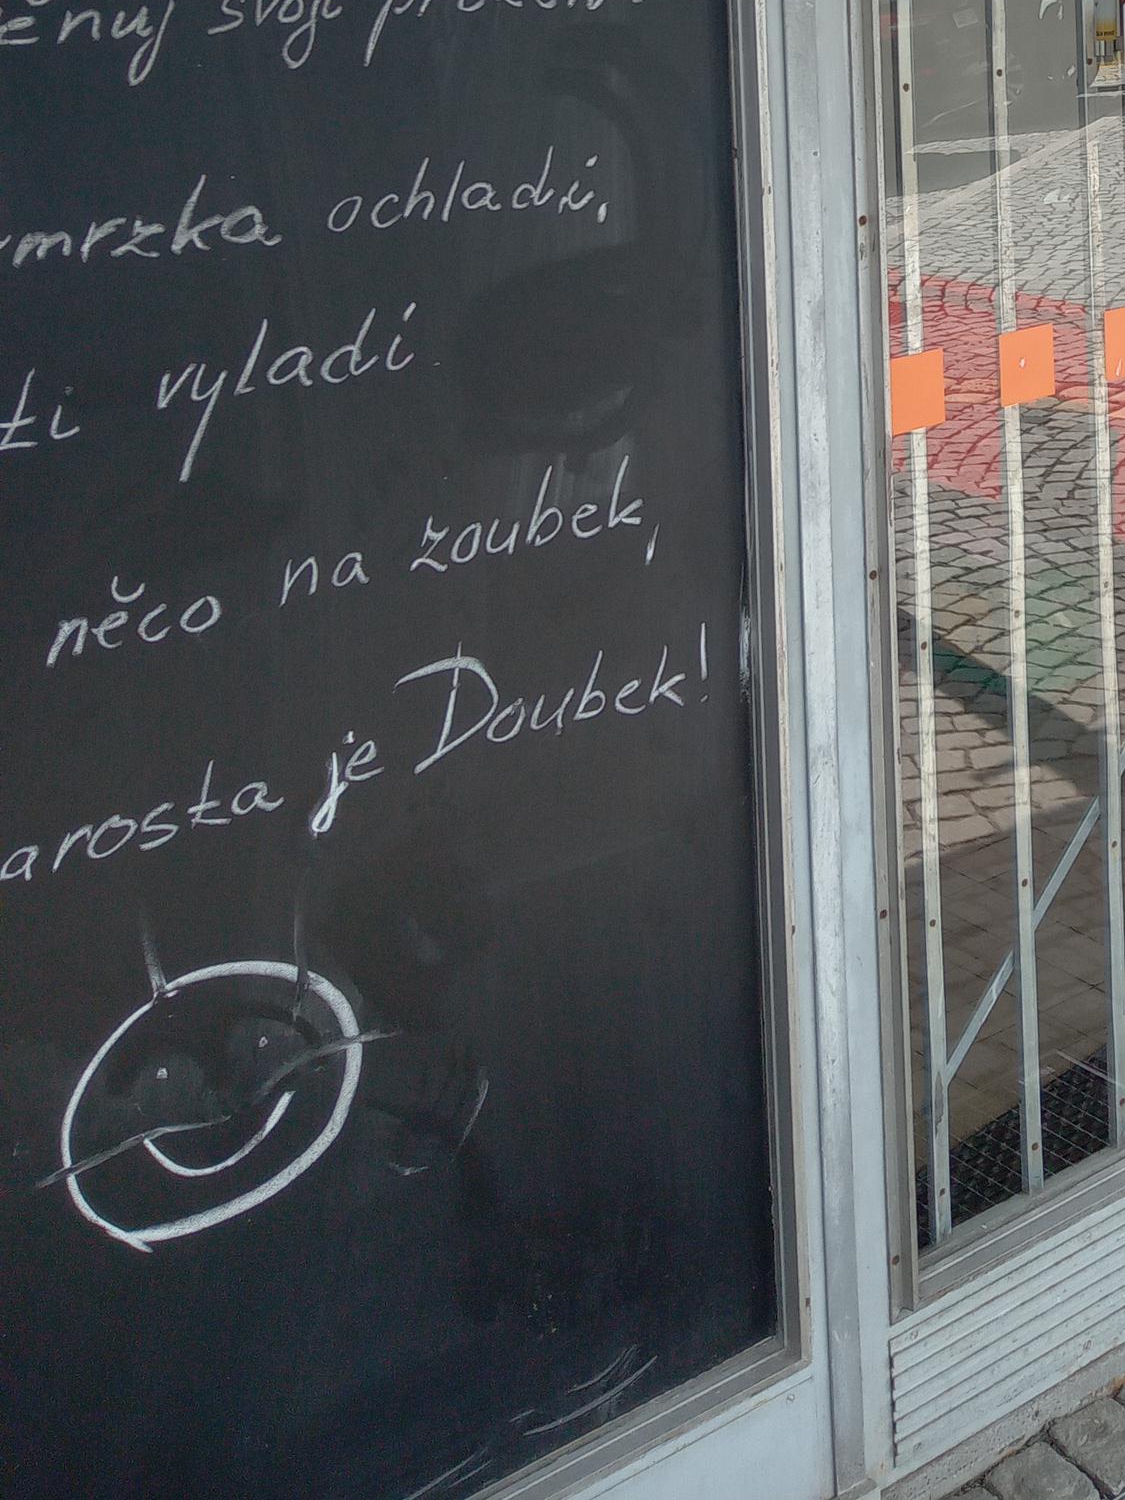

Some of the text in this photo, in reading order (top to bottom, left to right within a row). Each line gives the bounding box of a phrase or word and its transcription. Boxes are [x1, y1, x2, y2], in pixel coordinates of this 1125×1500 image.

[45, 575, 223, 669] něco
[279, 550, 371, 608] na
[310, 730, 385, 839] je
[393, 622, 710, 775] Doubek!
